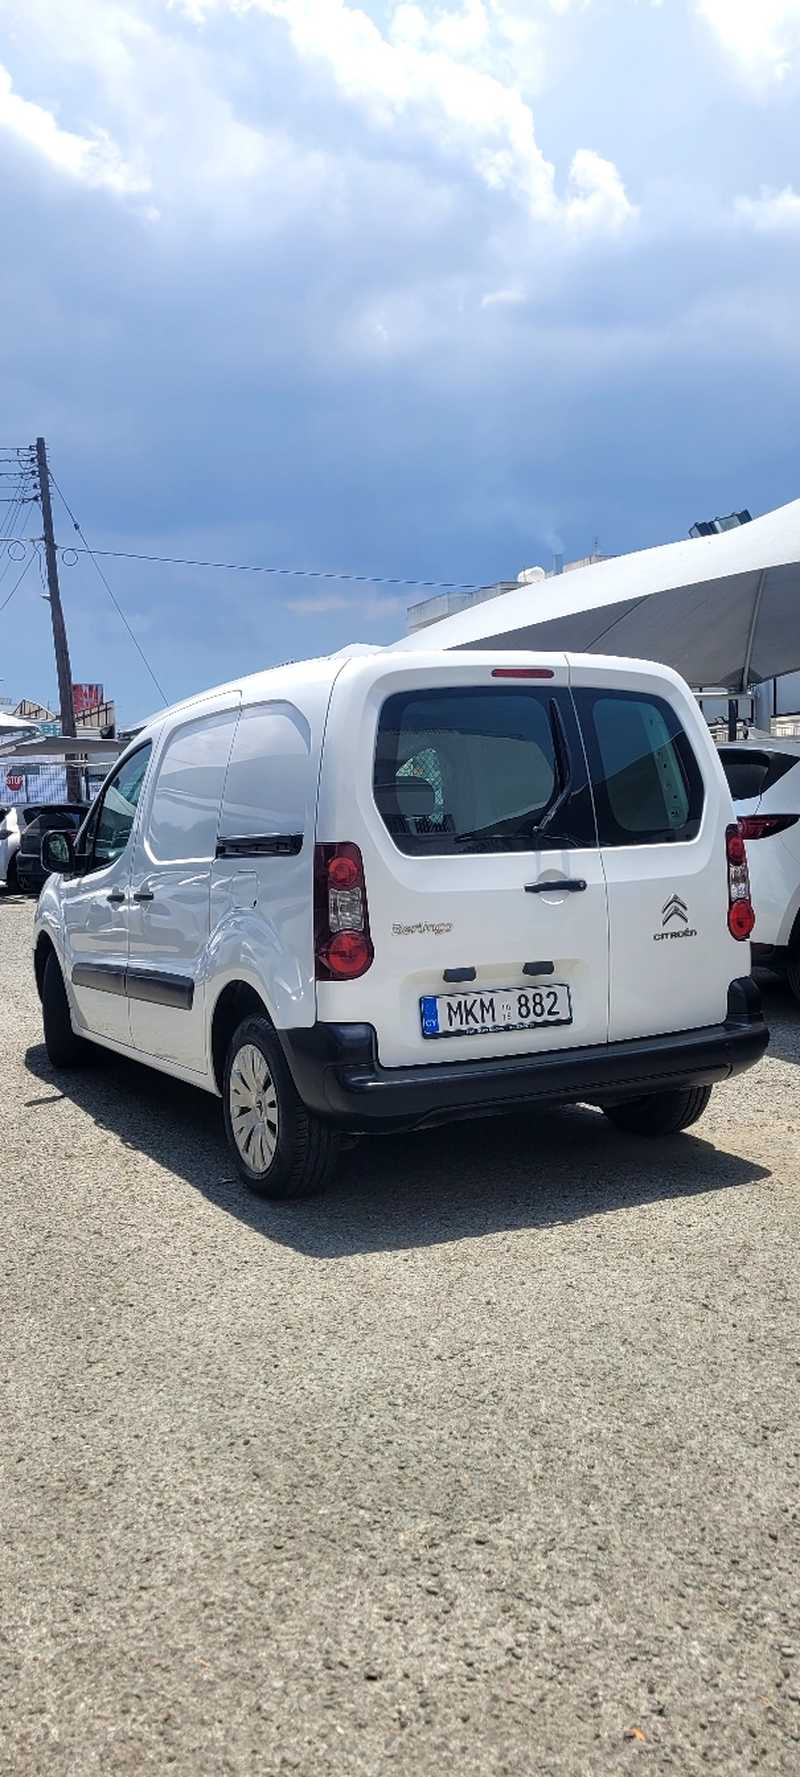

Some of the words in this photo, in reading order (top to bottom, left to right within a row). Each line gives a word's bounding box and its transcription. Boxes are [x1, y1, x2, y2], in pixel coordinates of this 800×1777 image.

[7, 775, 24, 785] STOP
[446, 998, 496, 1027] MKM
[517, 991, 560, 1019] 882
